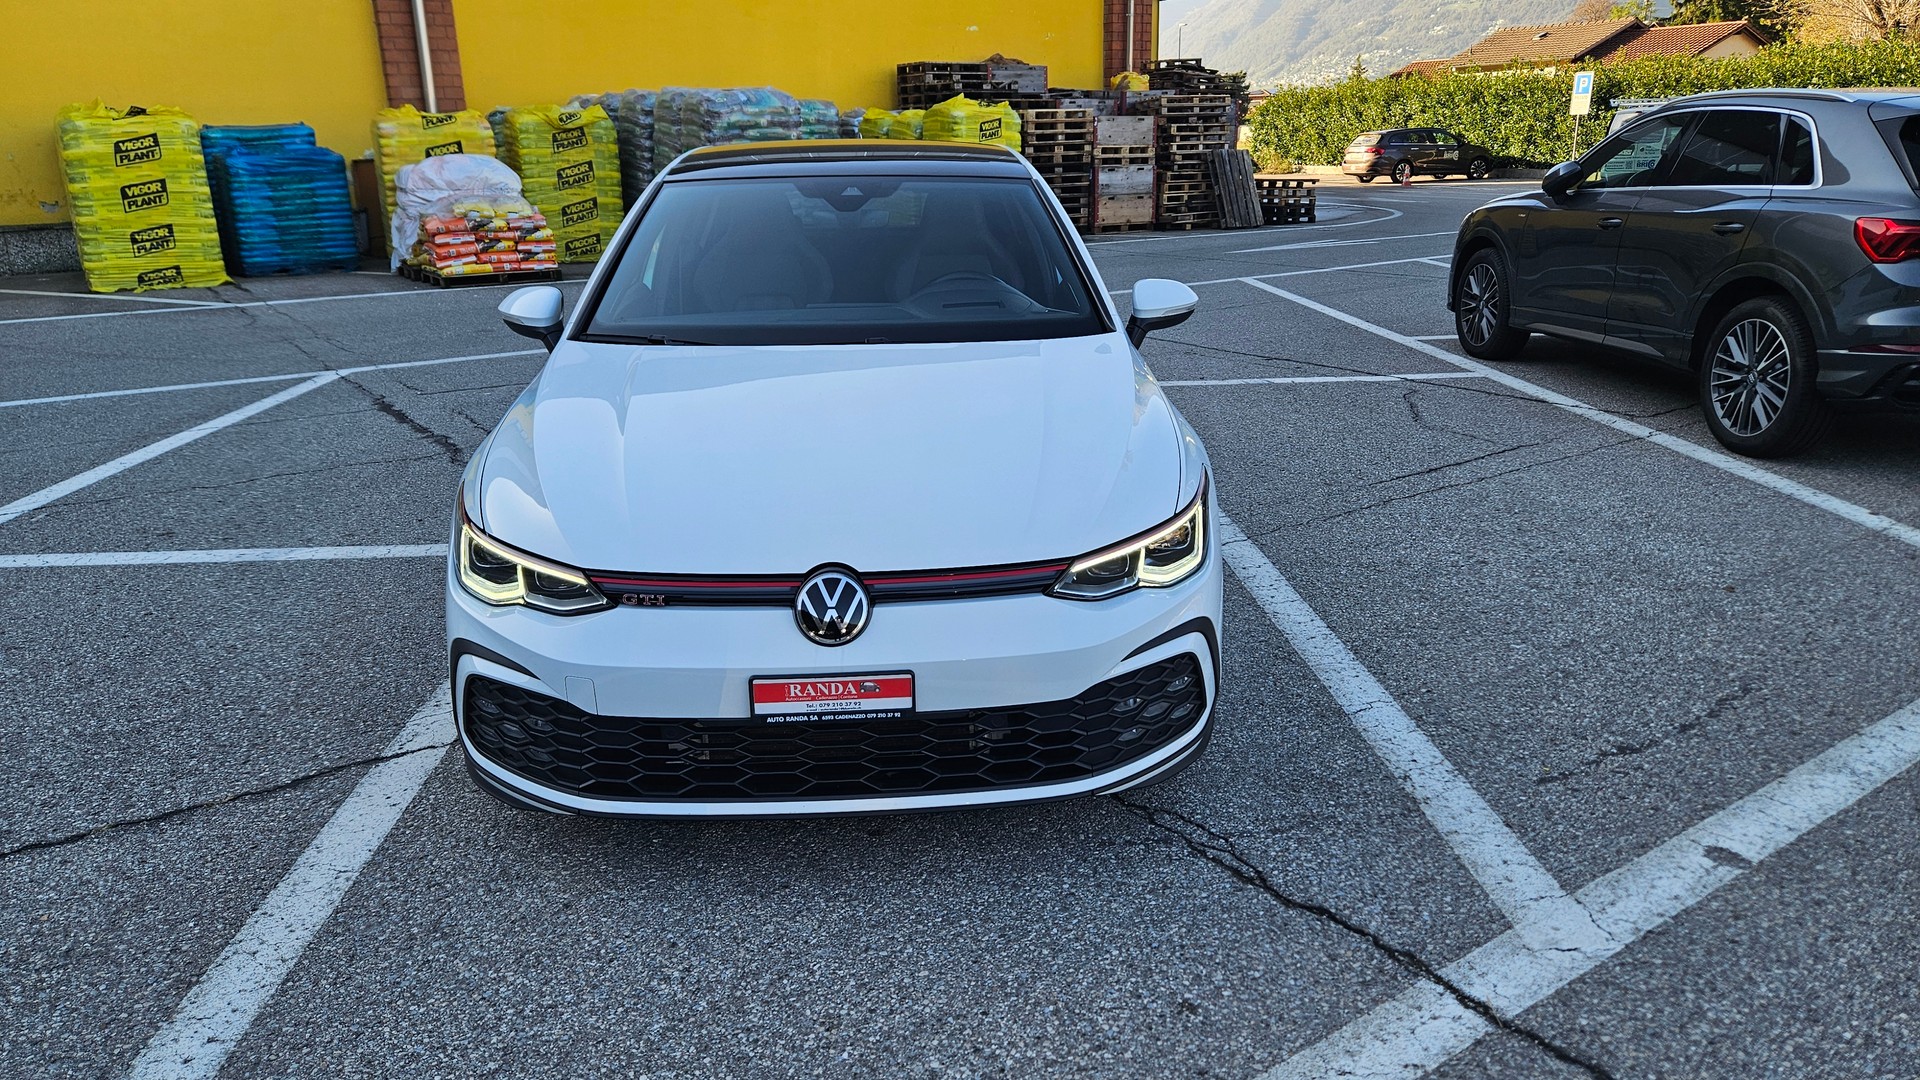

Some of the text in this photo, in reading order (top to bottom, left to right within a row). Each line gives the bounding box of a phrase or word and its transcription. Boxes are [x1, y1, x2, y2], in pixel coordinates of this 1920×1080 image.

[1579, 78, 1588, 92] P
[982, 121, 999, 130] VIGOR
[556, 129, 581, 140] VIGOR
[982, 130, 999, 139] PLANT
[119, 136, 155, 151] VIGOR
[429, 144, 459, 156] VIGOR
[556, 139, 583, 150] PLANT
[120, 150, 157, 163] PLANT
[561, 164, 589, 177] VIGOR
[562, 174, 590, 187] PLANT
[125, 182, 162, 197] VIGOR
[128, 194, 164, 209] PLANT
[565, 201, 593, 214] VIGOR
[566, 211, 594, 225] PLANT
[134, 228, 169, 241] VIGOR
[137, 240, 171, 254] PLANT
[569, 237, 597, 249] VIGOR
[569, 246, 598, 256] PLANT
[142, 269, 177, 281] VIGOR
[622, 594, 664, 606] GTI
[790, 682, 857, 696] RANDA
